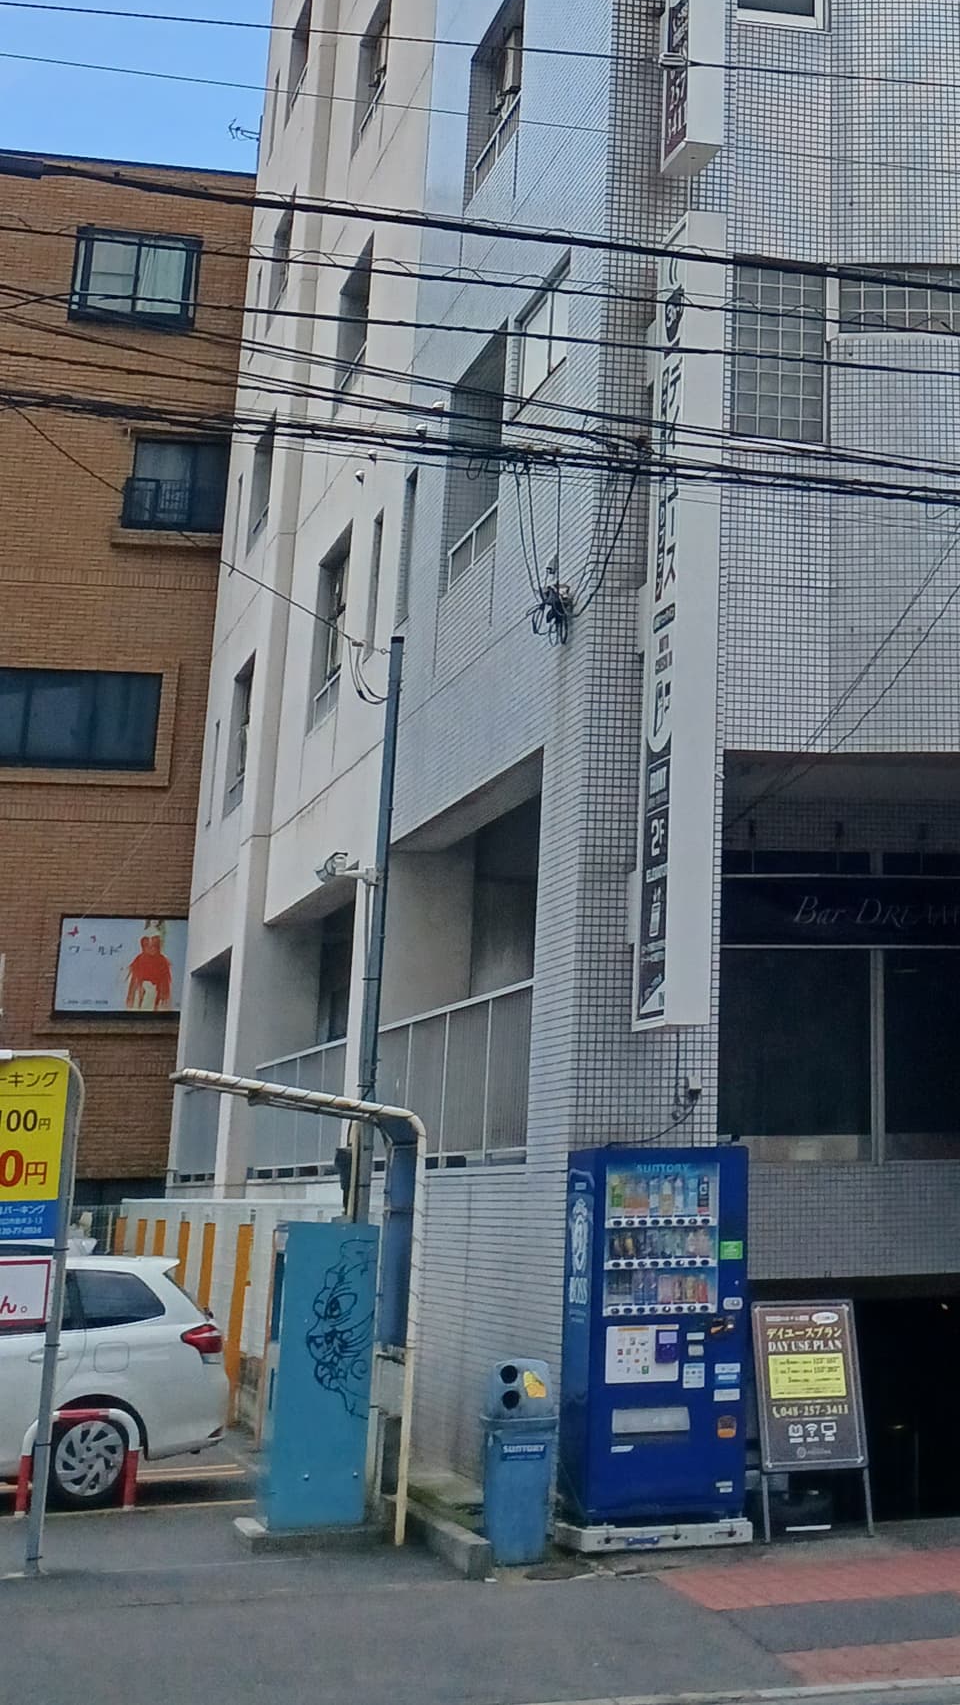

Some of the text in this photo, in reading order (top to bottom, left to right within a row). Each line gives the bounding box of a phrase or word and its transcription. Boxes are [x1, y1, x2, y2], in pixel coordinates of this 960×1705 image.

[651, 818, 665, 856] 2F
[793, 895, 846, 925] Bar
[0, 1109, 51, 1132] 00円
[766, 1326, 842, 1340] デイユースプラン
[768, 1339, 842, 1352] DAY USE PLAN
[780, 1404, 849, 1416] 048-257-3411
